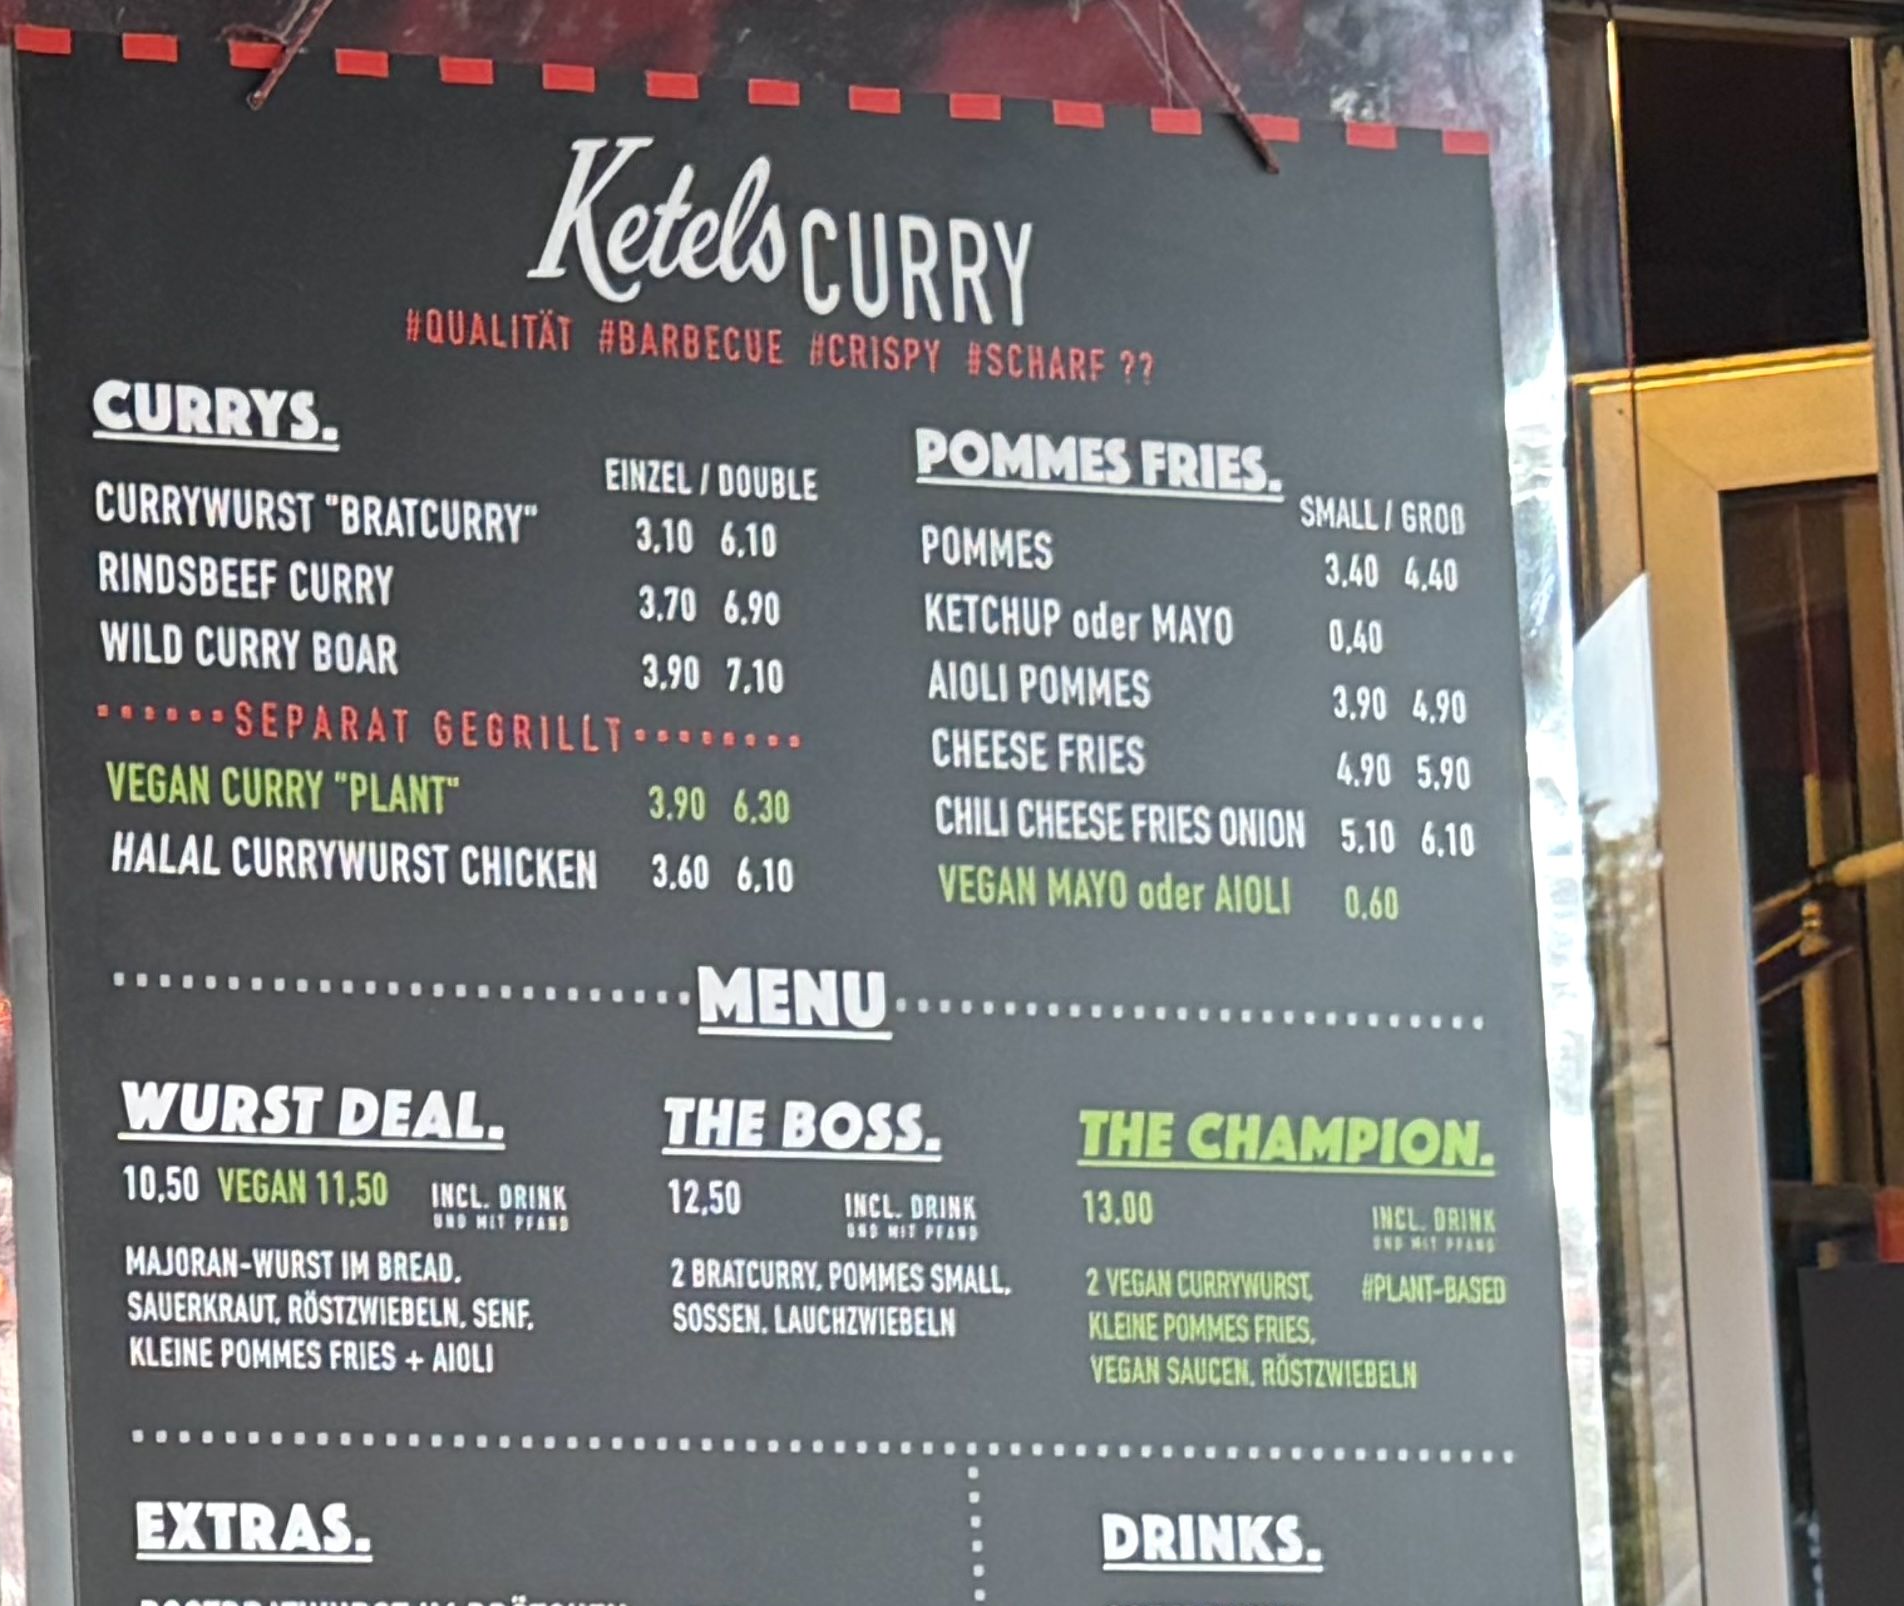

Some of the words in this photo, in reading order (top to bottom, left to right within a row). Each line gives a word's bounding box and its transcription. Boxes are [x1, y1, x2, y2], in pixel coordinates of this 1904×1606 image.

[527, 133, 789, 301] Ketels
[801, 205, 1037, 328] CURRY
[405, 307, 573, 352] #QUALITÄT
[598, 318, 785, 366] #BARBECUE
[809, 332, 941, 374] #CRISPY
[967, 341, 1105, 382] #SCHARF
[1119, 349, 1154, 381] ??
[92, 379, 339, 442] CURRYS.
[604, 457, 693, 496] EINZEL
[717, 463, 819, 502] DOUBLE
[915, 428, 1131, 485] POMMES
[1141, 440, 1282, 492] FRIES.
[95, 479, 316, 534] CURRYWURST
[1299, 494, 1380, 531] SMALL
[921, 524, 1054, 571] POMMES
[98, 550, 278, 601] RINDSBEEF
[288, 559, 395, 607] CURRY
[924, 592, 1062, 638] KETCHUP
[1072, 600, 1143, 642] oder
[1151, 603, 1234, 646] MAYO
[99, 619, 184, 665] WILD
[195, 624, 301, 671] CURRY
[312, 630, 399, 676] BOAR
[928, 659, 1009, 703] AIOLI
[1019, 663, 1152, 709] POMMES
[234, 699, 409, 744] SEPARAT
[433, 709, 622, 753] GEGRILLT
[931, 727, 1049, 772] CHEESE
[1058, 732, 1146, 776] FRIES
[105, 760, 211, 806] VEGAN
[221, 766, 324, 810] CURRY
[935, 794, 1010, 838] CHILI
[1016, 798, 1125, 842] CHEESE
[1131, 803, 1213, 845] FRIES
[1218, 806, 1307, 849] ONION
[111, 830, 222, 877] HALAL
[231, 835, 451, 885] CURRYWURST
[460, 844, 598, 890] CHICKEN
[938, 863, 1037, 906] VEGAN
[1047, 867, 1128, 909] MAYO
[1138, 871, 1205, 911] oder
[1214, 874, 1291, 915] AIOLI
[697, 965, 886, 1028] MENU
[121, 1080, 324, 1135] WURST
[338, 1087, 504, 1141] DEAL.
[664, 1097, 766, 1147] THE
[782, 1100, 941, 1152] BOSS.
[1080, 1110, 1173, 1157] THE
[1188, 1113, 1493, 1168] CHAMPION.
[217, 1166, 307, 1204] VEGAN
[125, 1244, 335, 1280] MAJORAN-WURST
[341, 1250, 371, 1281] IM
[670, 1257, 686, 1288] 2
[828, 1260, 925, 1293] POMMES
[1085, 1267, 1100, 1297] 2
[1105, 1268, 1172, 1298] VEGAN
[1361, 1273, 1507, 1305] #PLANT-BASED
[773, 1303, 956, 1338] LAUCHZWIEBELN
[1088, 1311, 1159, 1342] KLEINE
[1163, 1312, 1250, 1343] POMMES
[129, 1335, 214, 1369] KLEINE
[220, 1337, 323, 1370] POMMES
[328, 1339, 398, 1372] FRIES
[432, 1341, 494, 1374] AIOLI
[1090, 1355, 1161, 1385] VEGAN
[136, 1501, 371, 1553] EXTRAS.
[1102, 1513, 1322, 1563] DRINKS.
